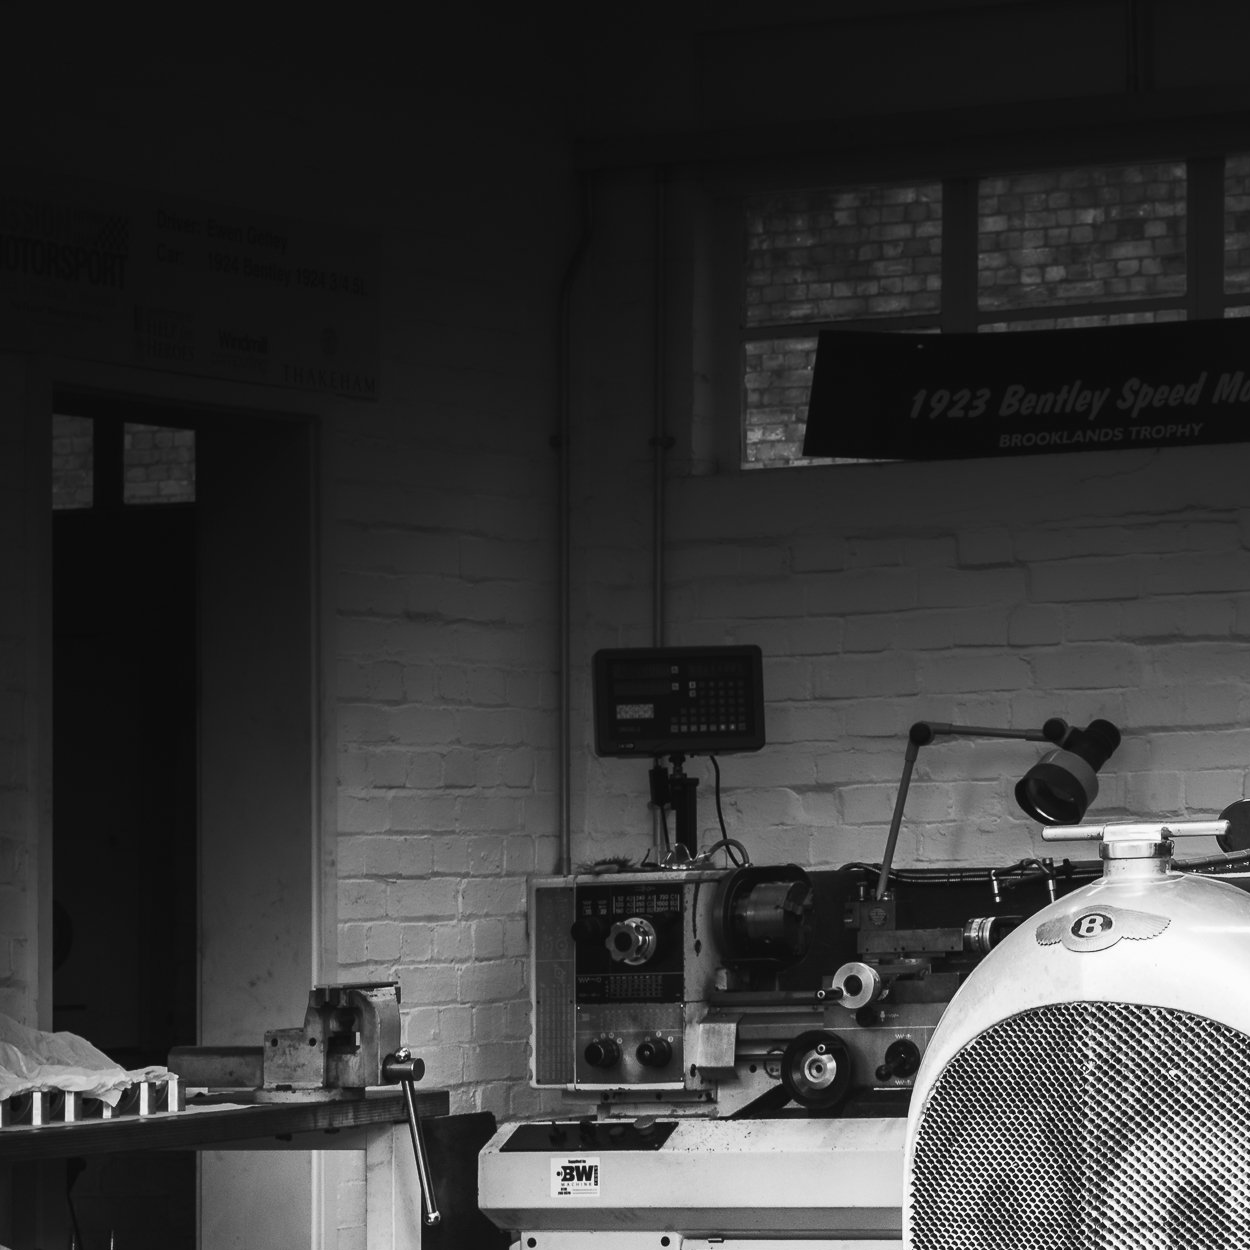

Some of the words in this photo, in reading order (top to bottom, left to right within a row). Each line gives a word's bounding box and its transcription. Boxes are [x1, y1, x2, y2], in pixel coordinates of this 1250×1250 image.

[208, 250, 239, 273] 1924
[243, 257, 291, 288] Bentley
[909, 388, 991, 419] 1923
[998, 379, 1110, 421] Bentley
[1116, 371, 1208, 417] Speed
[999, 427, 1124, 448] BROOKLANDS
[1128, 422, 1204, 443] TROPHY
[561, 1165, 594, 1182] BW
